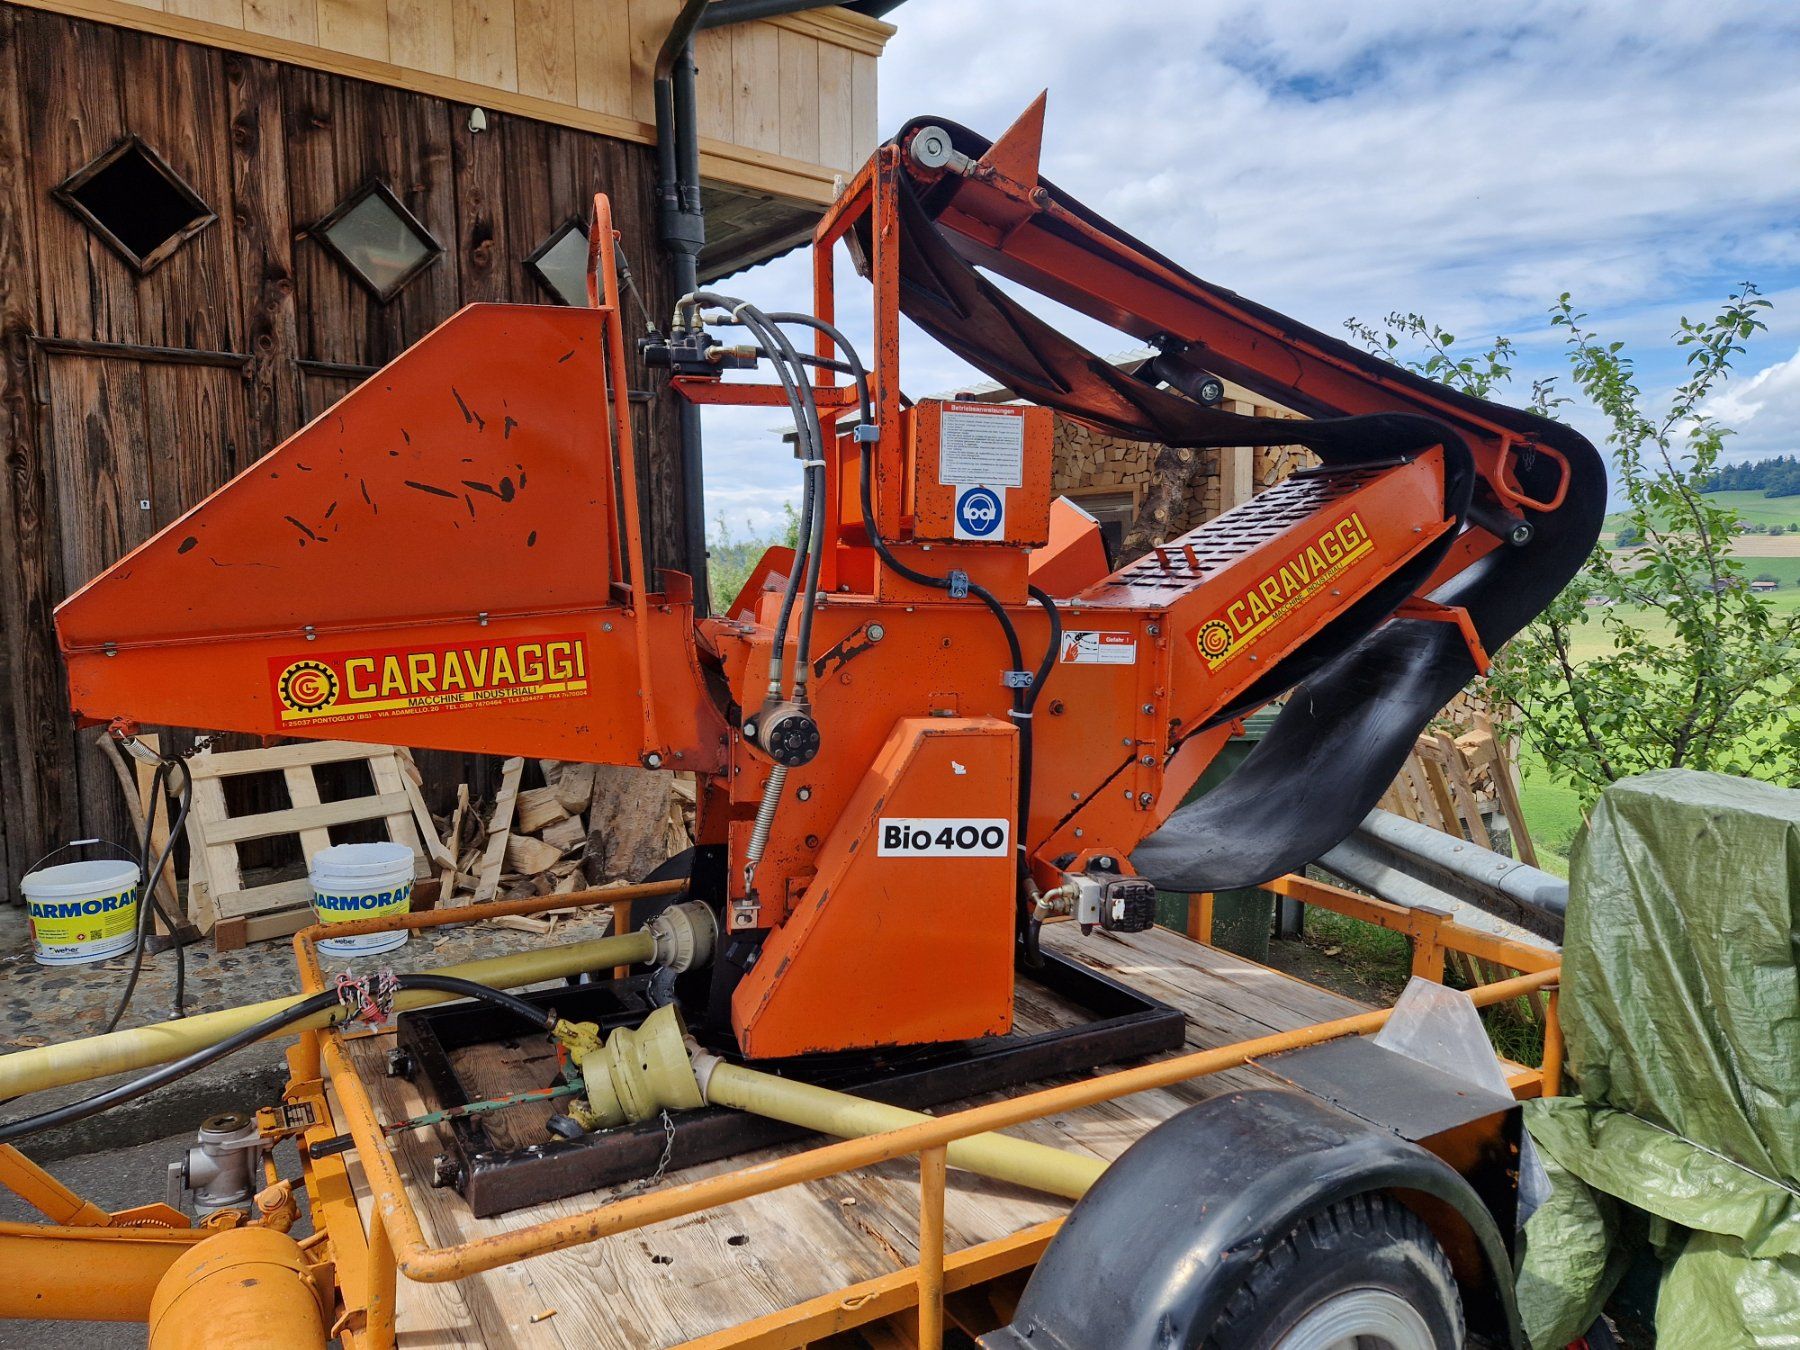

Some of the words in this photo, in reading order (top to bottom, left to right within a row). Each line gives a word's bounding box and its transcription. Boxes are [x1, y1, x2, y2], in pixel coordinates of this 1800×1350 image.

[1226, 512, 1368, 635] CARAVAGGI
[1271, 592, 1305, 620] MACCHINE
[1306, 562, 1343, 593] INDUSTRIALI
[344, 640, 587, 700] CARAVAGGI
[408, 694, 465, 707] MACCHINE
[473, 686, 537, 700] INDUSTRIALI
